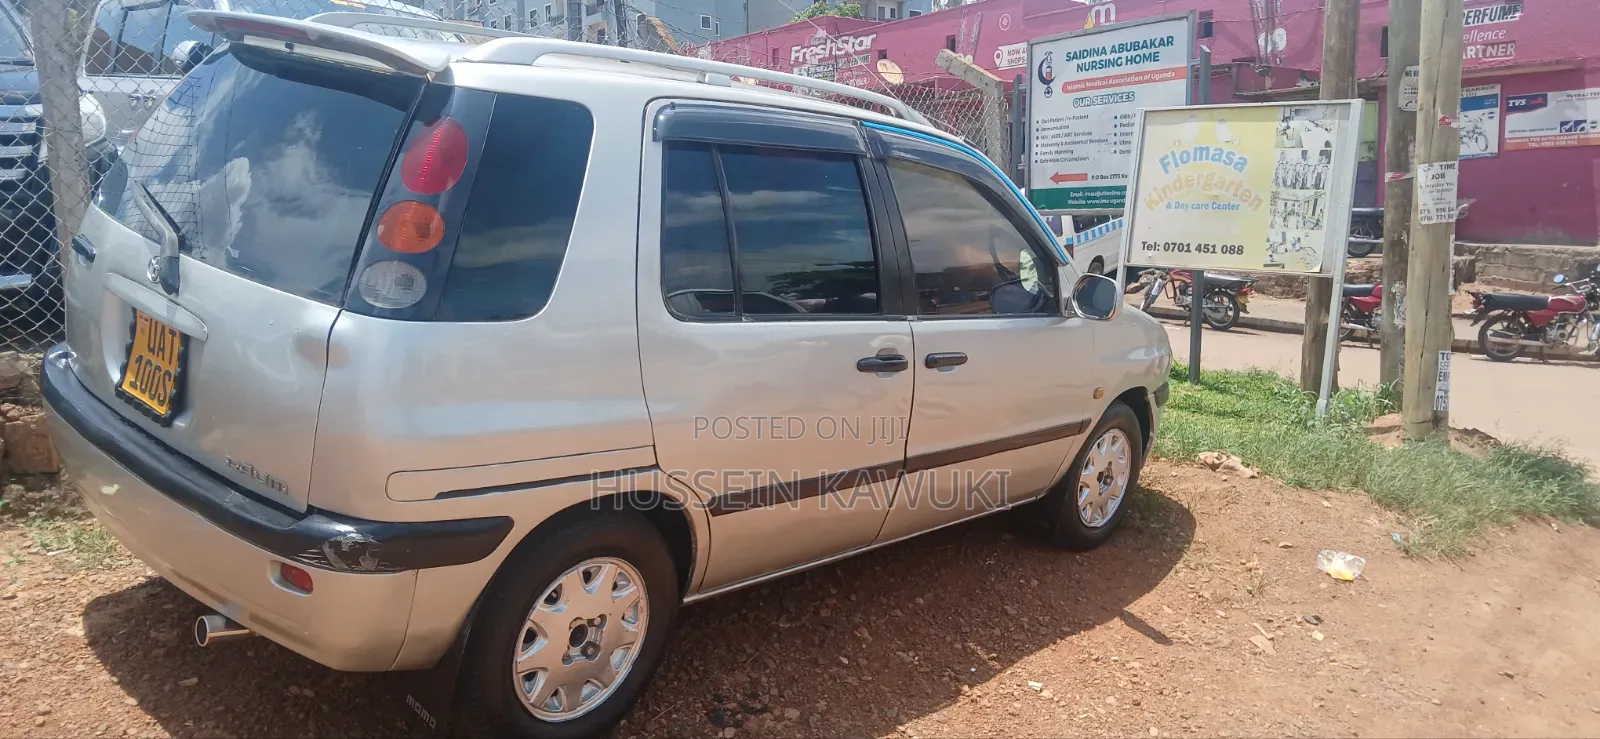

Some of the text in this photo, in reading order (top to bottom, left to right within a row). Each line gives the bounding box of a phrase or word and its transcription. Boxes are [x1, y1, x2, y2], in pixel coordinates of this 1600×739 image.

[1463, 5, 1521, 25] ERFUME
[790, 34, 877, 64] FreshStar
[1065, 36, 1174, 62] SAIDINA ABUBAKAR
[1007, 57, 1025, 65] SHOPS
[1076, 51, 1160, 73] NURSING HOME
[1066, 70, 1175, 91] Islamic Medical Association of Uganda
[1073, 91, 1135, 108] OUR SERVICES
[1508, 99, 1526, 107] TVS
[1158, 145, 1248, 175] Flomasa
[1144, 172, 1264, 212] Kindergarten
[1166, 201, 1172, 209] &
[1174, 201, 1189, 210] Day
[1211, 201, 1240, 211] Center
[1141, 241, 1244, 255] Tel: 0701 451 088
[148, 318, 177, 366] UAT
[129, 354, 173, 407] 100S
